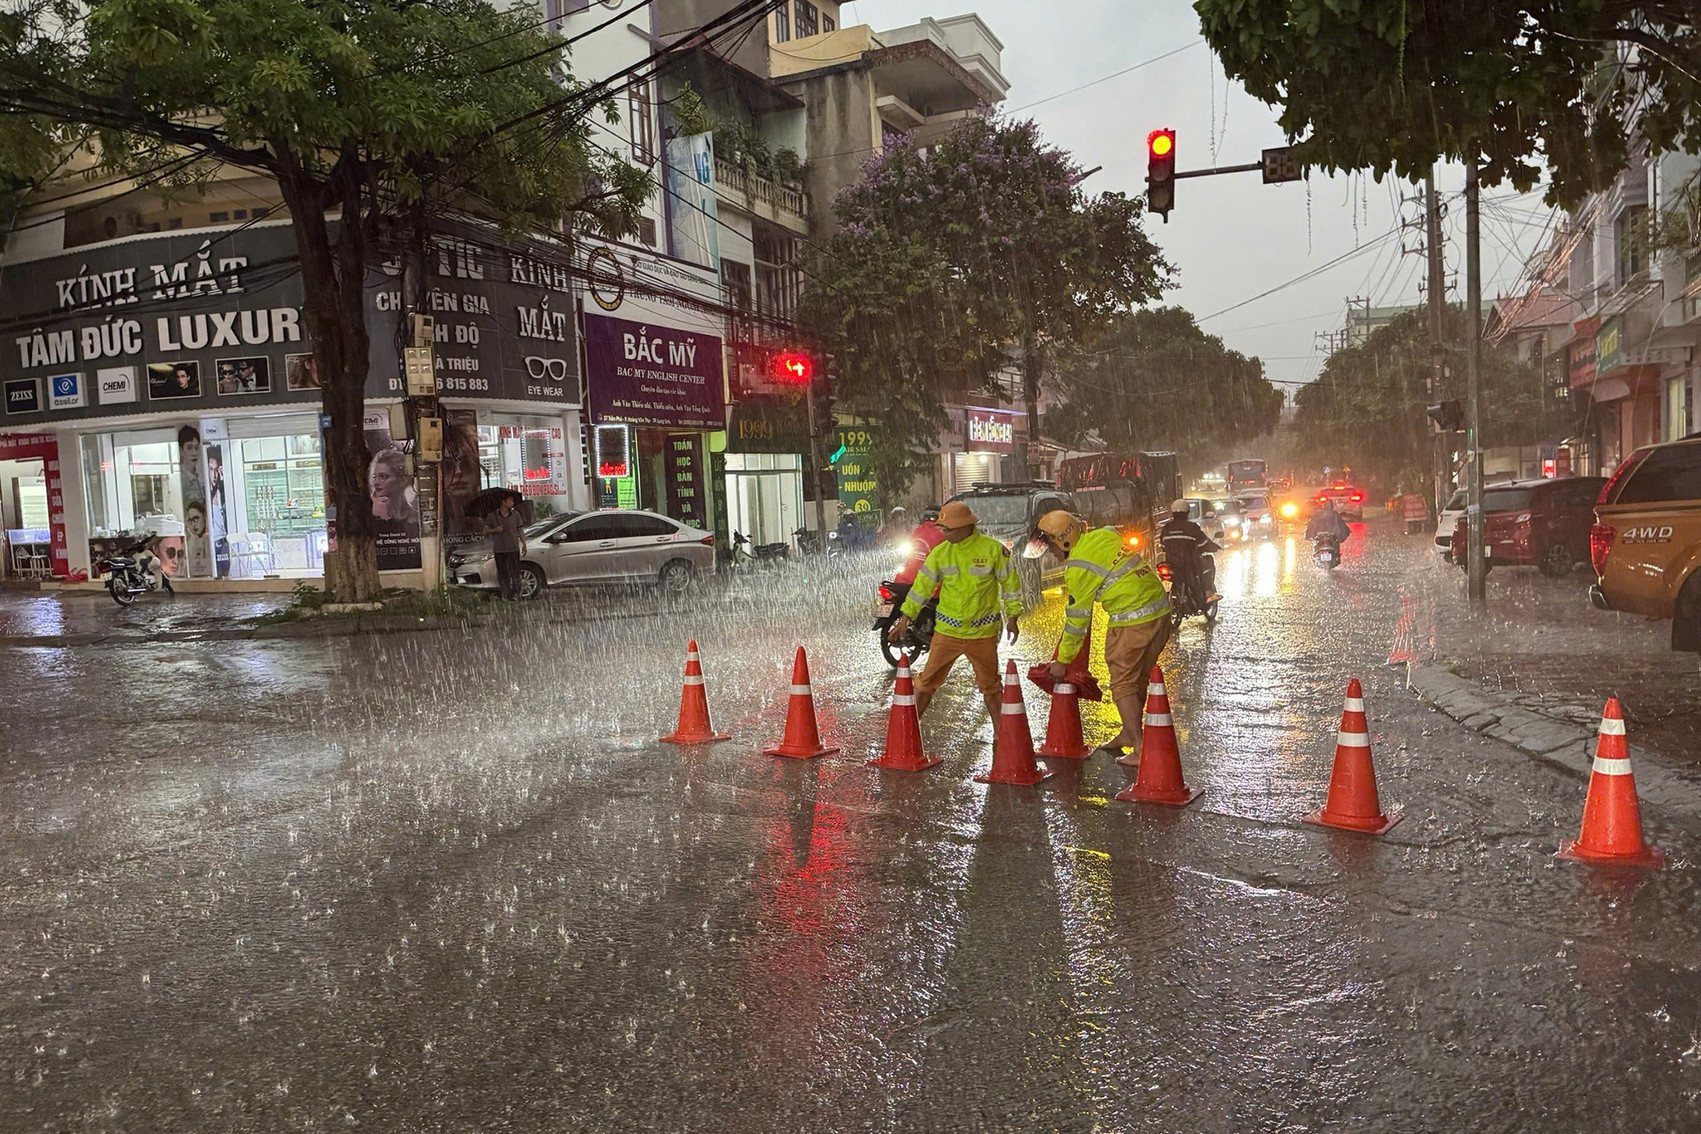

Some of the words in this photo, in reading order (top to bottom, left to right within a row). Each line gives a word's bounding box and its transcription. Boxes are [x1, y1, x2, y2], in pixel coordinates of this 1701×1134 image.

[55, 263, 139, 312] KÍNH
[151, 239, 249, 300] MẮT
[509, 247, 570, 292] KÍNH
[377, 287, 458, 312] CHÊN
[462, 293, 490, 315] GIA
[517, 294, 566, 341] MẮT
[16, 328, 75, 368] TÂM
[81, 315, 142, 361] ĐỨC
[157, 306, 302, 351] LUXUR
[455, 321, 480, 349] ĐỘ
[623, 326, 664, 364] BẮC
[668, 336, 697, 368] MỸ
[446, 356, 479, 373] TRIỆU
[617, 366, 633, 377] BAC
[634, 369, 646, 379] MY
[647, 371, 678, 382] ENGLISH
[679, 374, 705, 385] CENTER
[103, 380, 126, 391] CHEMI
[447, 378, 466, 390] 815
[469, 378, 489, 391] 883
[528, 385, 541, 396] EYE
[543, 386, 564, 397] WEAR
[10, 389, 34, 402] ZEISS
[673, 439, 692, 451] TOÁN
[676, 457, 691, 467] HỌC
[842, 461, 860, 475] UỐN
[677, 471, 692, 482] BÀN
[677, 486, 694, 498] TÍNH
[844, 480, 876, 494] NHUỘM
[681, 501, 692, 513] VÀ
[1623, 526, 1674, 539] 4WD
